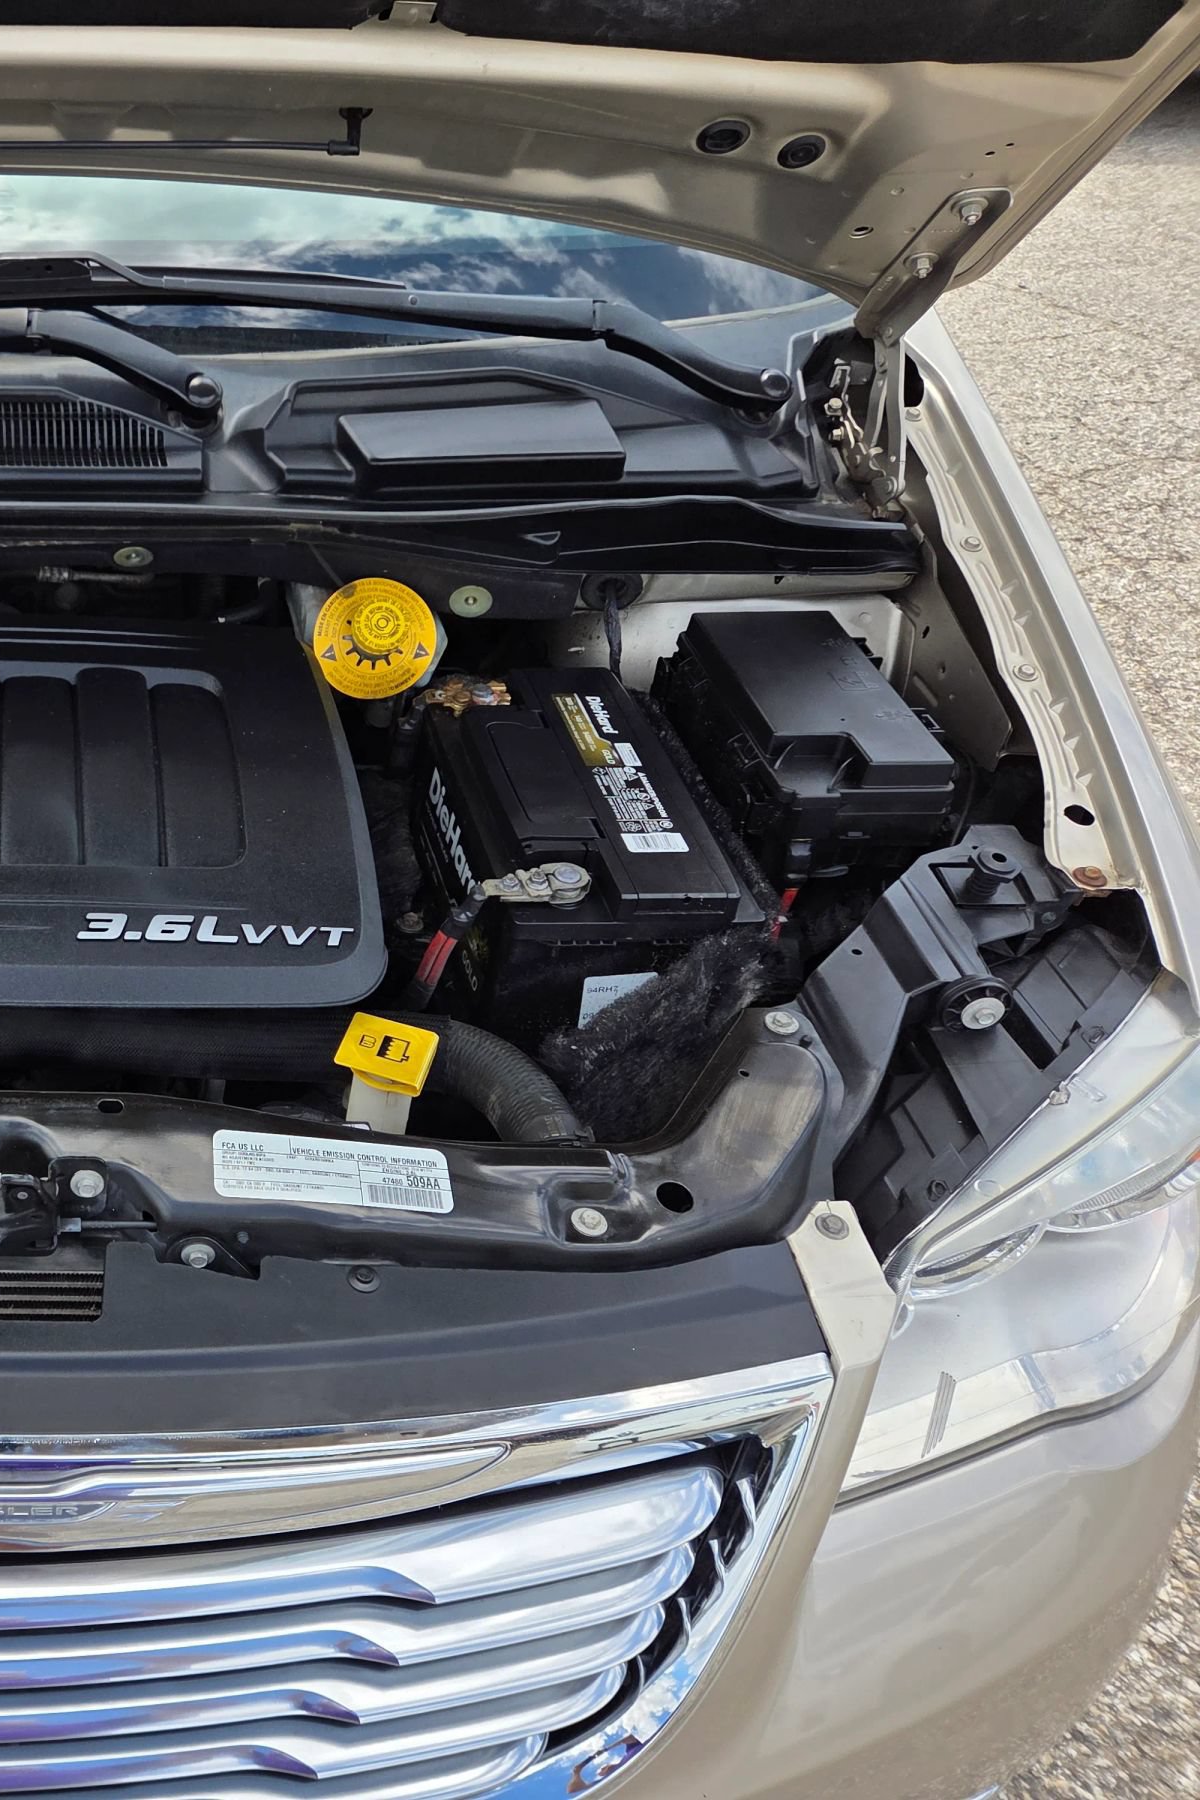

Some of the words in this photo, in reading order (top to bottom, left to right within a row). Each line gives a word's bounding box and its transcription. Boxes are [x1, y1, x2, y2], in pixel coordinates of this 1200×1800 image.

[584, 695, 620, 735] DieHard
[428, 765, 477, 897] DieHar
[461, 949, 479, 992] GOLD
[221, 1141, 236, 1150] FCA
[238, 1142, 248, 1151] US
[250, 1143, 264, 1152] LLC
[292, 1147, 320, 1157] VEHICLE
[322, 1149, 355, 1160] EMISSION
[357, 1153, 388, 1163] CONTROL
[390, 1156, 437, 1168] INFORMATION
[406, 1175, 441, 1190] 509AA
